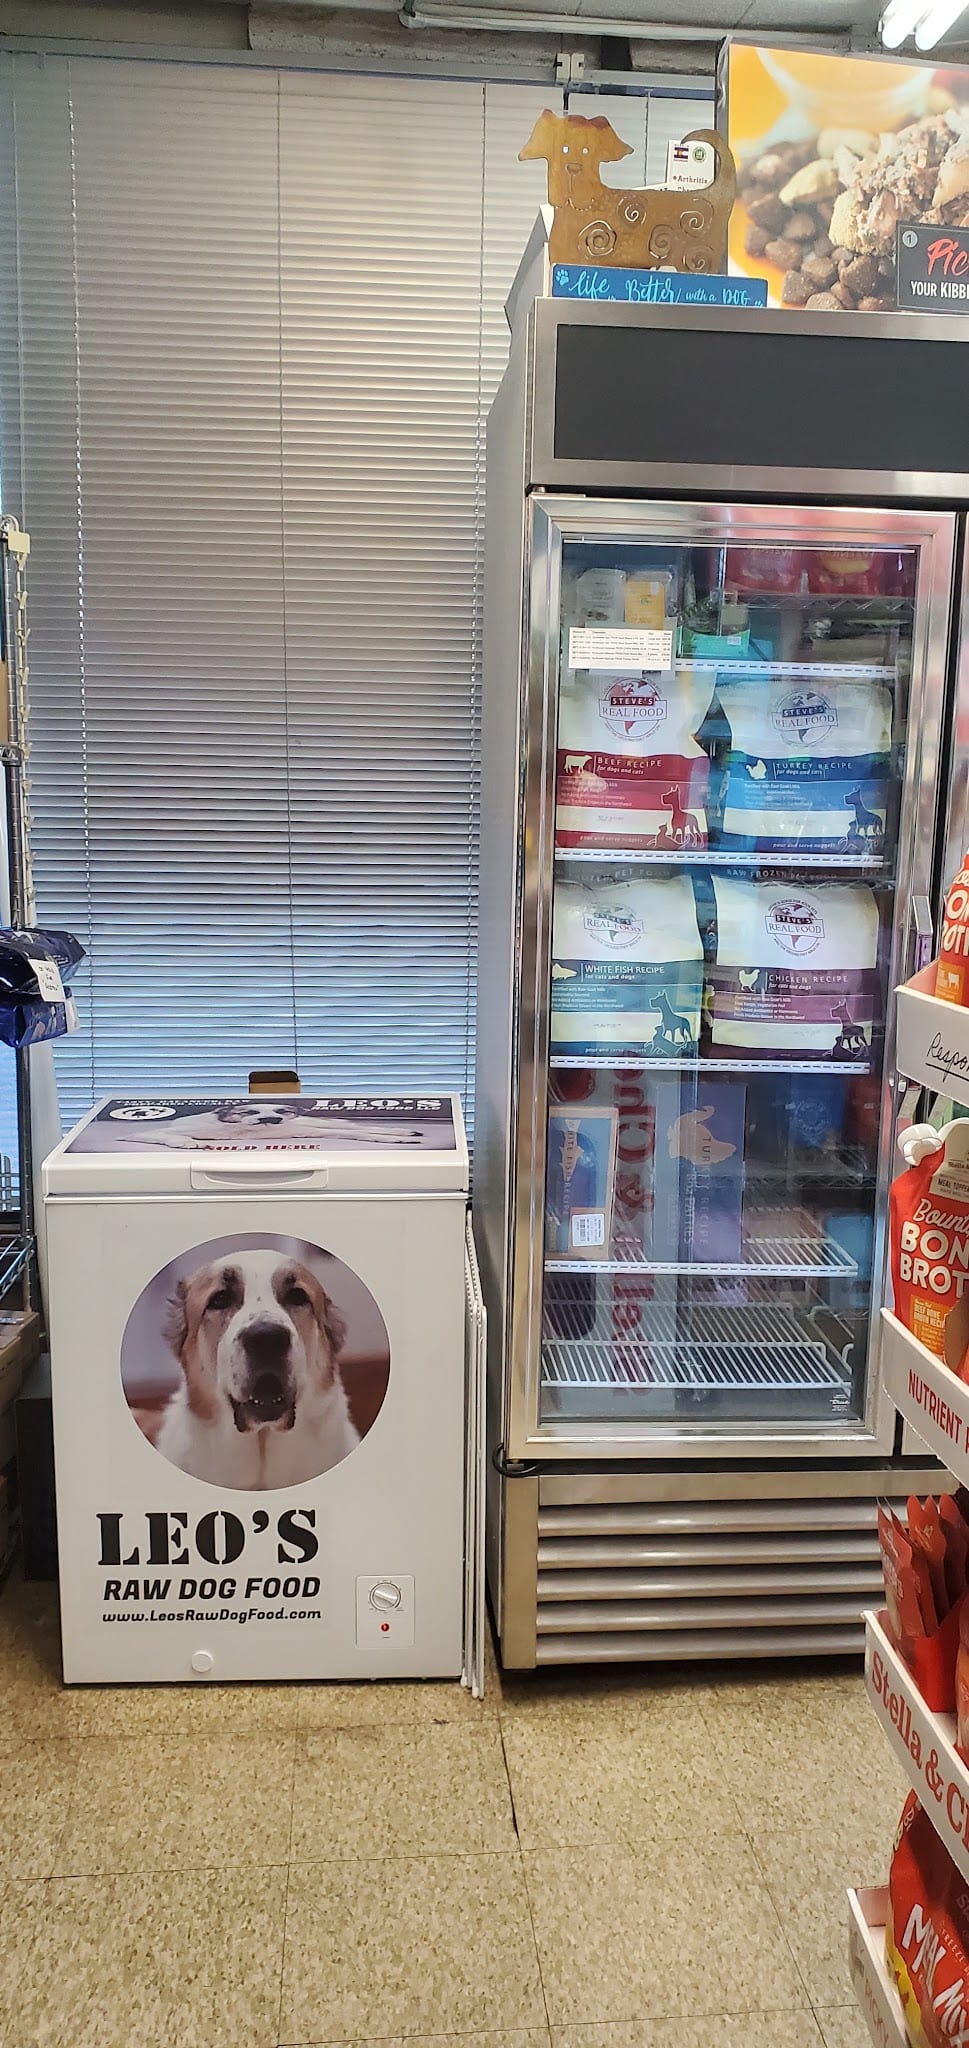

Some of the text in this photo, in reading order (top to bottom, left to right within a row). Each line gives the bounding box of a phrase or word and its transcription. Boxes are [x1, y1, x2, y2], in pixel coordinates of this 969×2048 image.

[910, 280, 937, 297] YOUR
[612, 697, 653, 705] STEVE'S
[602, 707, 664, 718] REAL FOOD
[775, 715, 835, 728] REAL FOOD
[597, 757, 662, 769] BEEF RECIPE
[776, 762, 852, 770] TURKEY RECIPE
[607, 766, 621, 774] dogs
[726, 868, 747, 877] RAW
[586, 917, 612, 928] REAL
[768, 923, 821, 934] REAL FOOD
[585, 964, 665, 975] WHITE FISH RECIPE
[768, 974, 849, 984] CHICKEN RECIPE
[926, 1031, 969, 1083] Respo
[315, 1099, 442, 1107] LEO'S
[908, 1368, 963, 1445] NUTRIENT
[95, 1509, 320, 1567] LEO'S
[103, 1576, 321, 1601] RAW DOG FOOD
[102, 1606, 322, 1624] www.LeosRawDogFood.com
[871, 1649, 923, 1771] Stella
[925, 1747, 945, 1804] &
